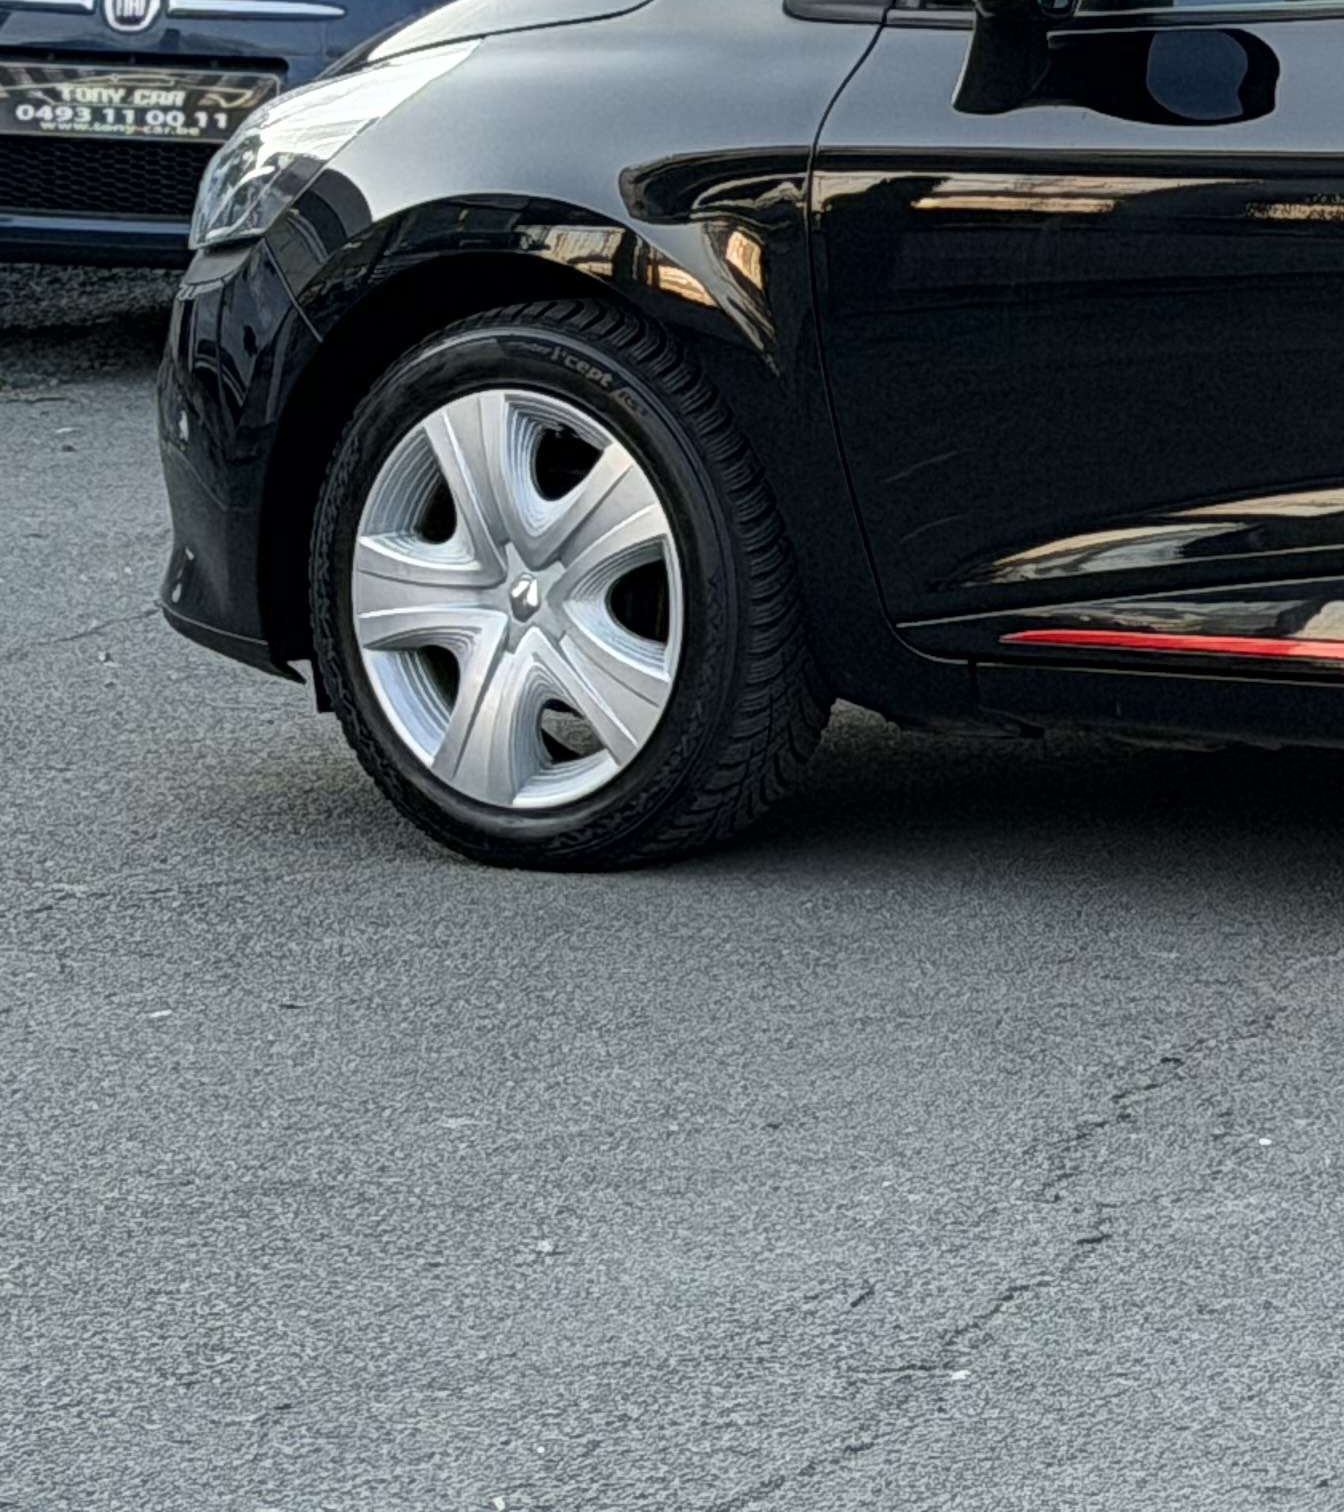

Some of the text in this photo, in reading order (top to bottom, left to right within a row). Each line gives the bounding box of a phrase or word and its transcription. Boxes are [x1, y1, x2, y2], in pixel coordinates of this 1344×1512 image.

[15, 104, 227, 129] 0493 11 00 11
